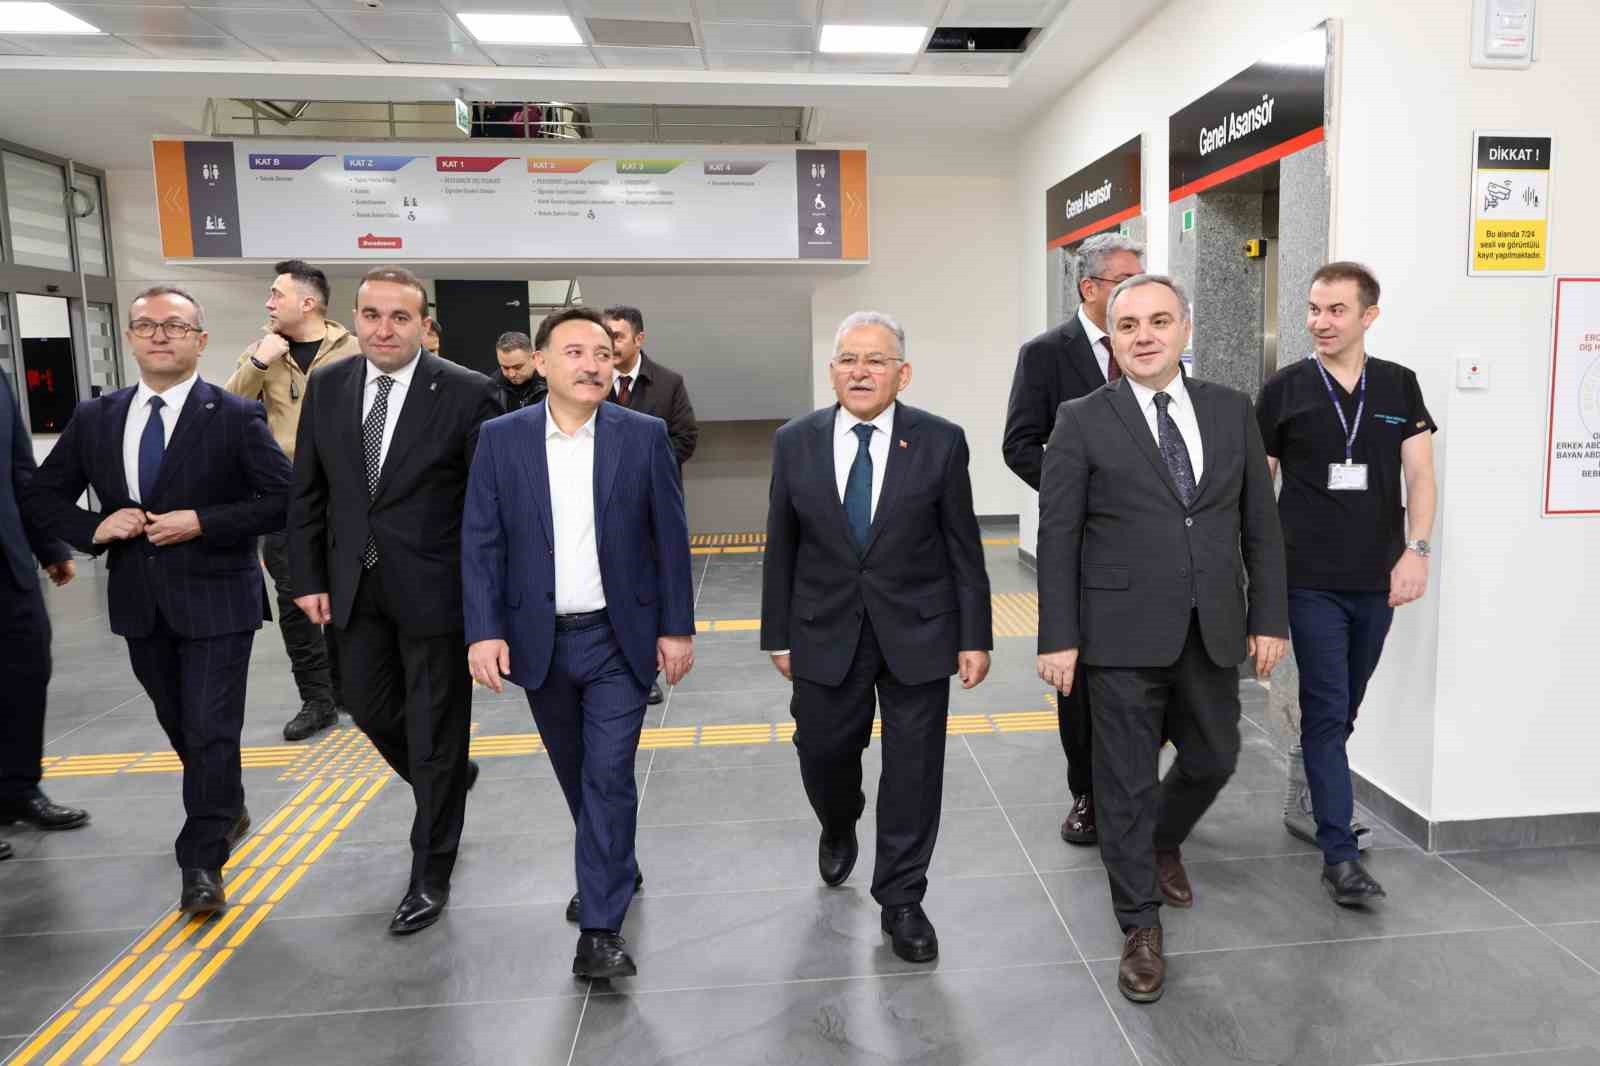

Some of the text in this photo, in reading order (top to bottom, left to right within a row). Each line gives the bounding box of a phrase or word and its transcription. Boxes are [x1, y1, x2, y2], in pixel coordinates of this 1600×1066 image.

[1199, 94, 1275, 156] Genel Asansör
[1488, 145, 1540, 161] DİKKAT !
[255, 158, 272, 166] KAT
[349, 159, 366, 168] KAT
[441, 160, 465, 169] KAT 1
[1066, 178, 1113, 219] Genel Asansör
[1486, 229, 1496, 238] Bu
[1497, 229, 1520, 238] alanda
[1497, 241, 1506, 249] ve
[1556, 441, 1584, 449] ERKEK
[1556, 450, 1583, 459] BAYAN
